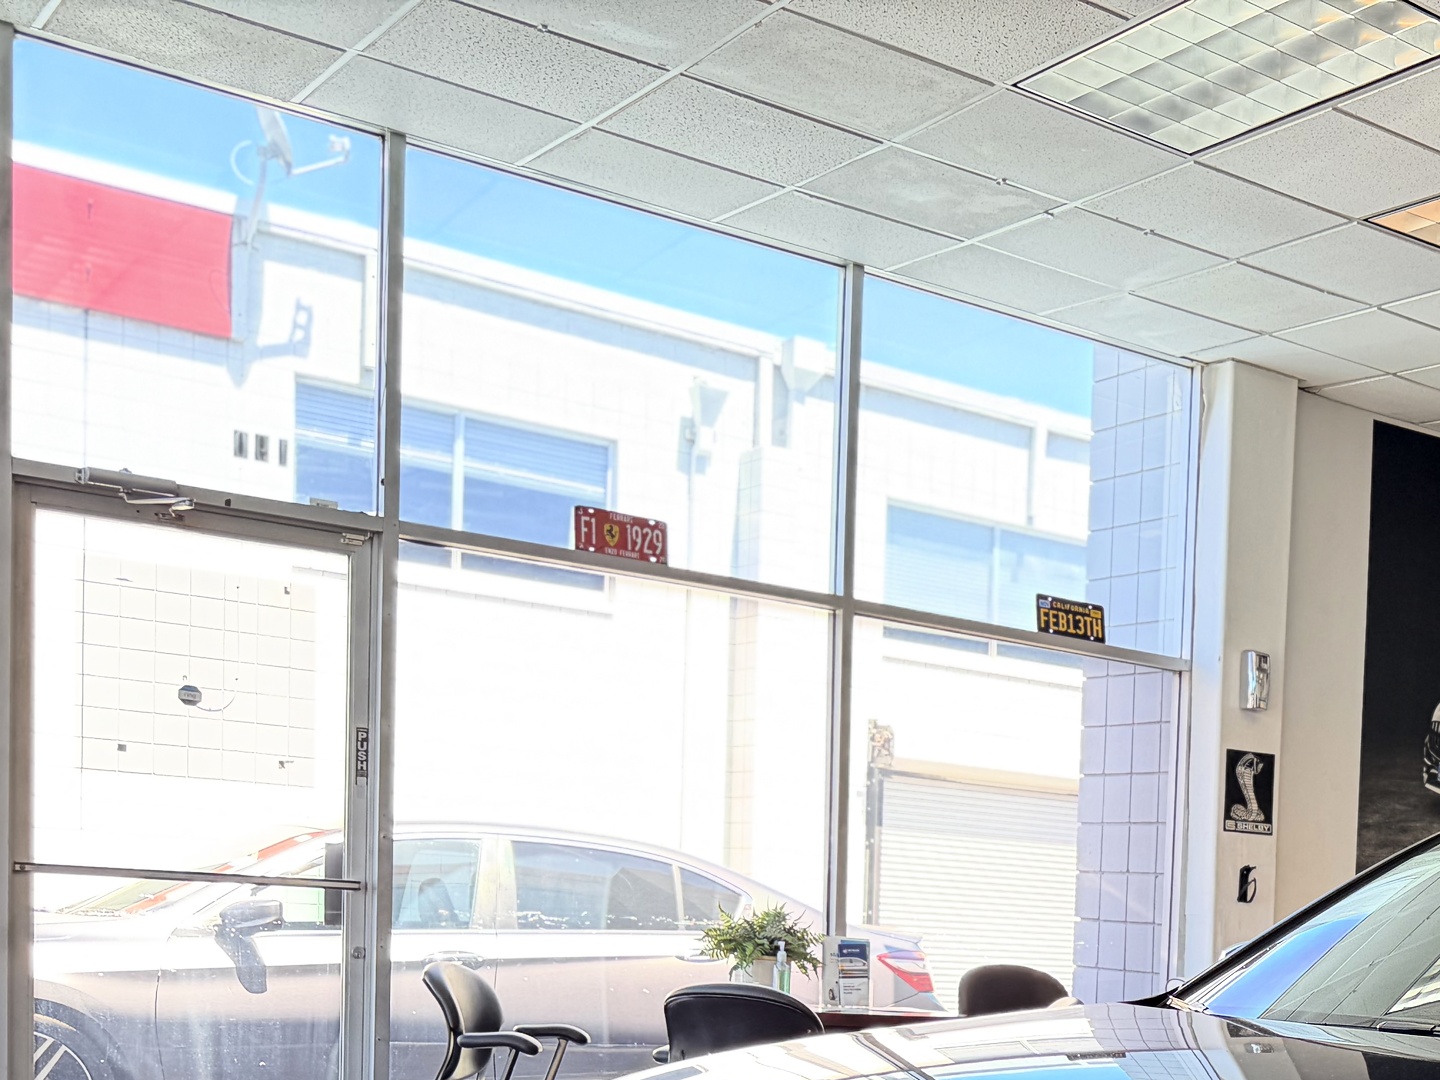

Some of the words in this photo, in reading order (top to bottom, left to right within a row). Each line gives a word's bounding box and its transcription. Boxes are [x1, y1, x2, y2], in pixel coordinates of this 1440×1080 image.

[581, 515, 596, 545] F1
[626, 523, 662, 555] 1929
[1040, 607, 1103, 639] FEB13TH
[1052, 601, 1090, 615] CALIFORNIA
[357, 731, 367, 771] PUSH
[1236, 821, 1271, 834] SHELBY
